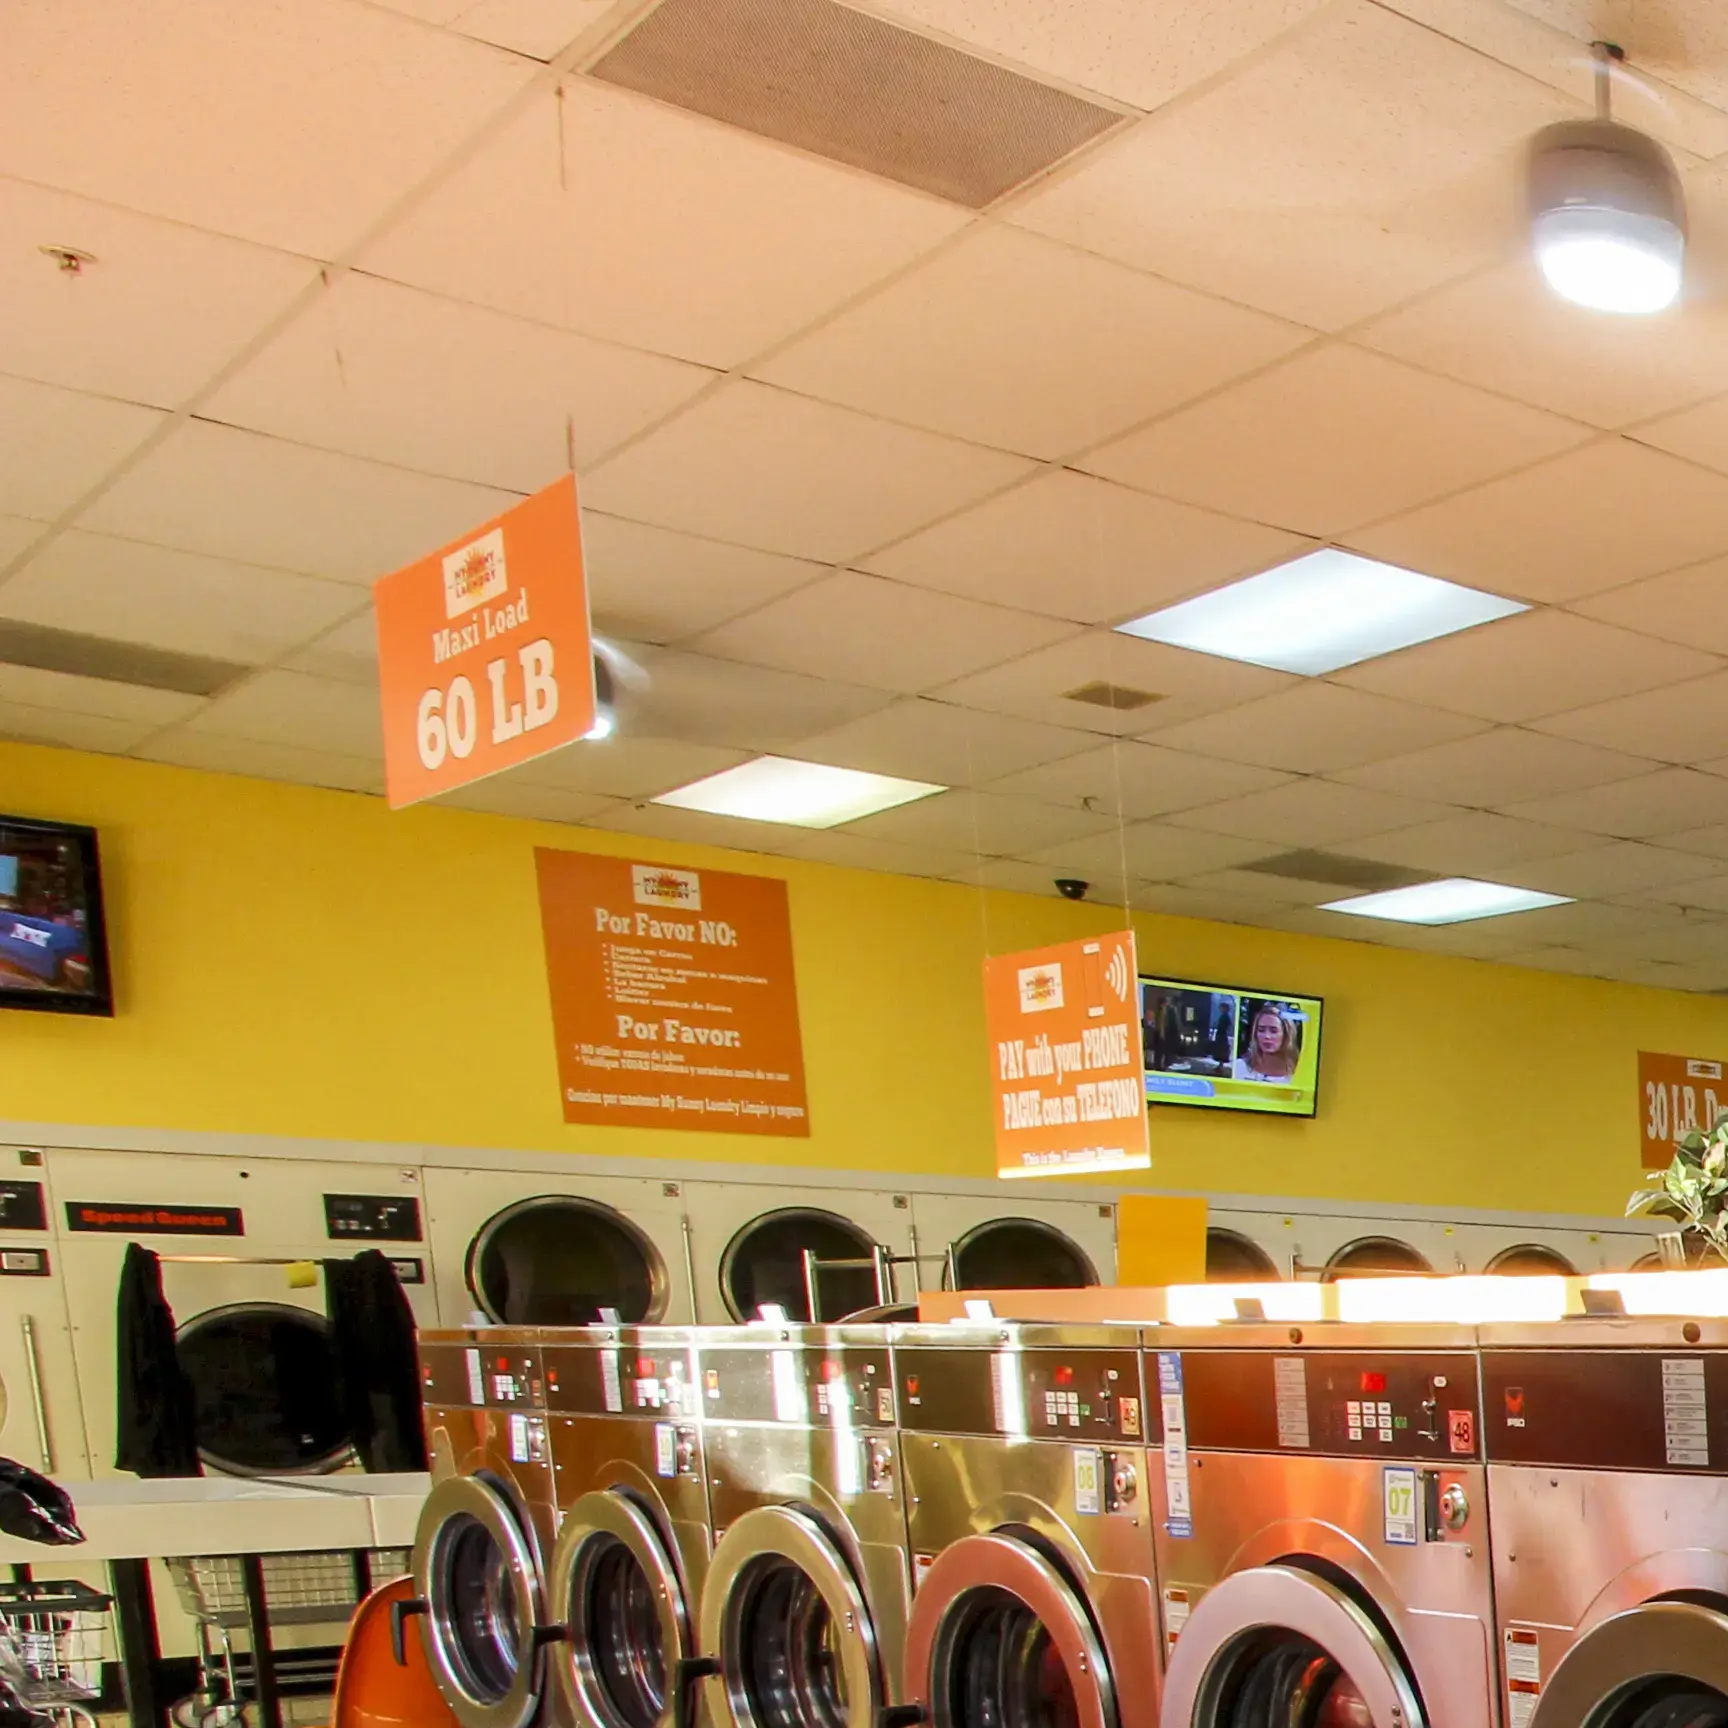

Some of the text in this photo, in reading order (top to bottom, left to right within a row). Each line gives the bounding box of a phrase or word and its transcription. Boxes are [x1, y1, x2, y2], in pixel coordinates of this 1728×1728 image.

[432, 587, 529, 664] Maxi Load
[417, 638, 558, 770] 60 LB
[594, 906, 738, 947] Por Favor NO:
[616, 1014, 741, 1048] Por Favor:
[998, 1023, 1130, 1086] PAY with your PHONE
[1002, 1077, 1140, 1130] PAGUE con su TELEFONO
[1646, 1081, 1668, 1141] 30
[1454, 1422, 1470, 1443] 48
[1078, 1465, 1095, 1490] 08
[1388, 1487, 1412, 1516] 07
